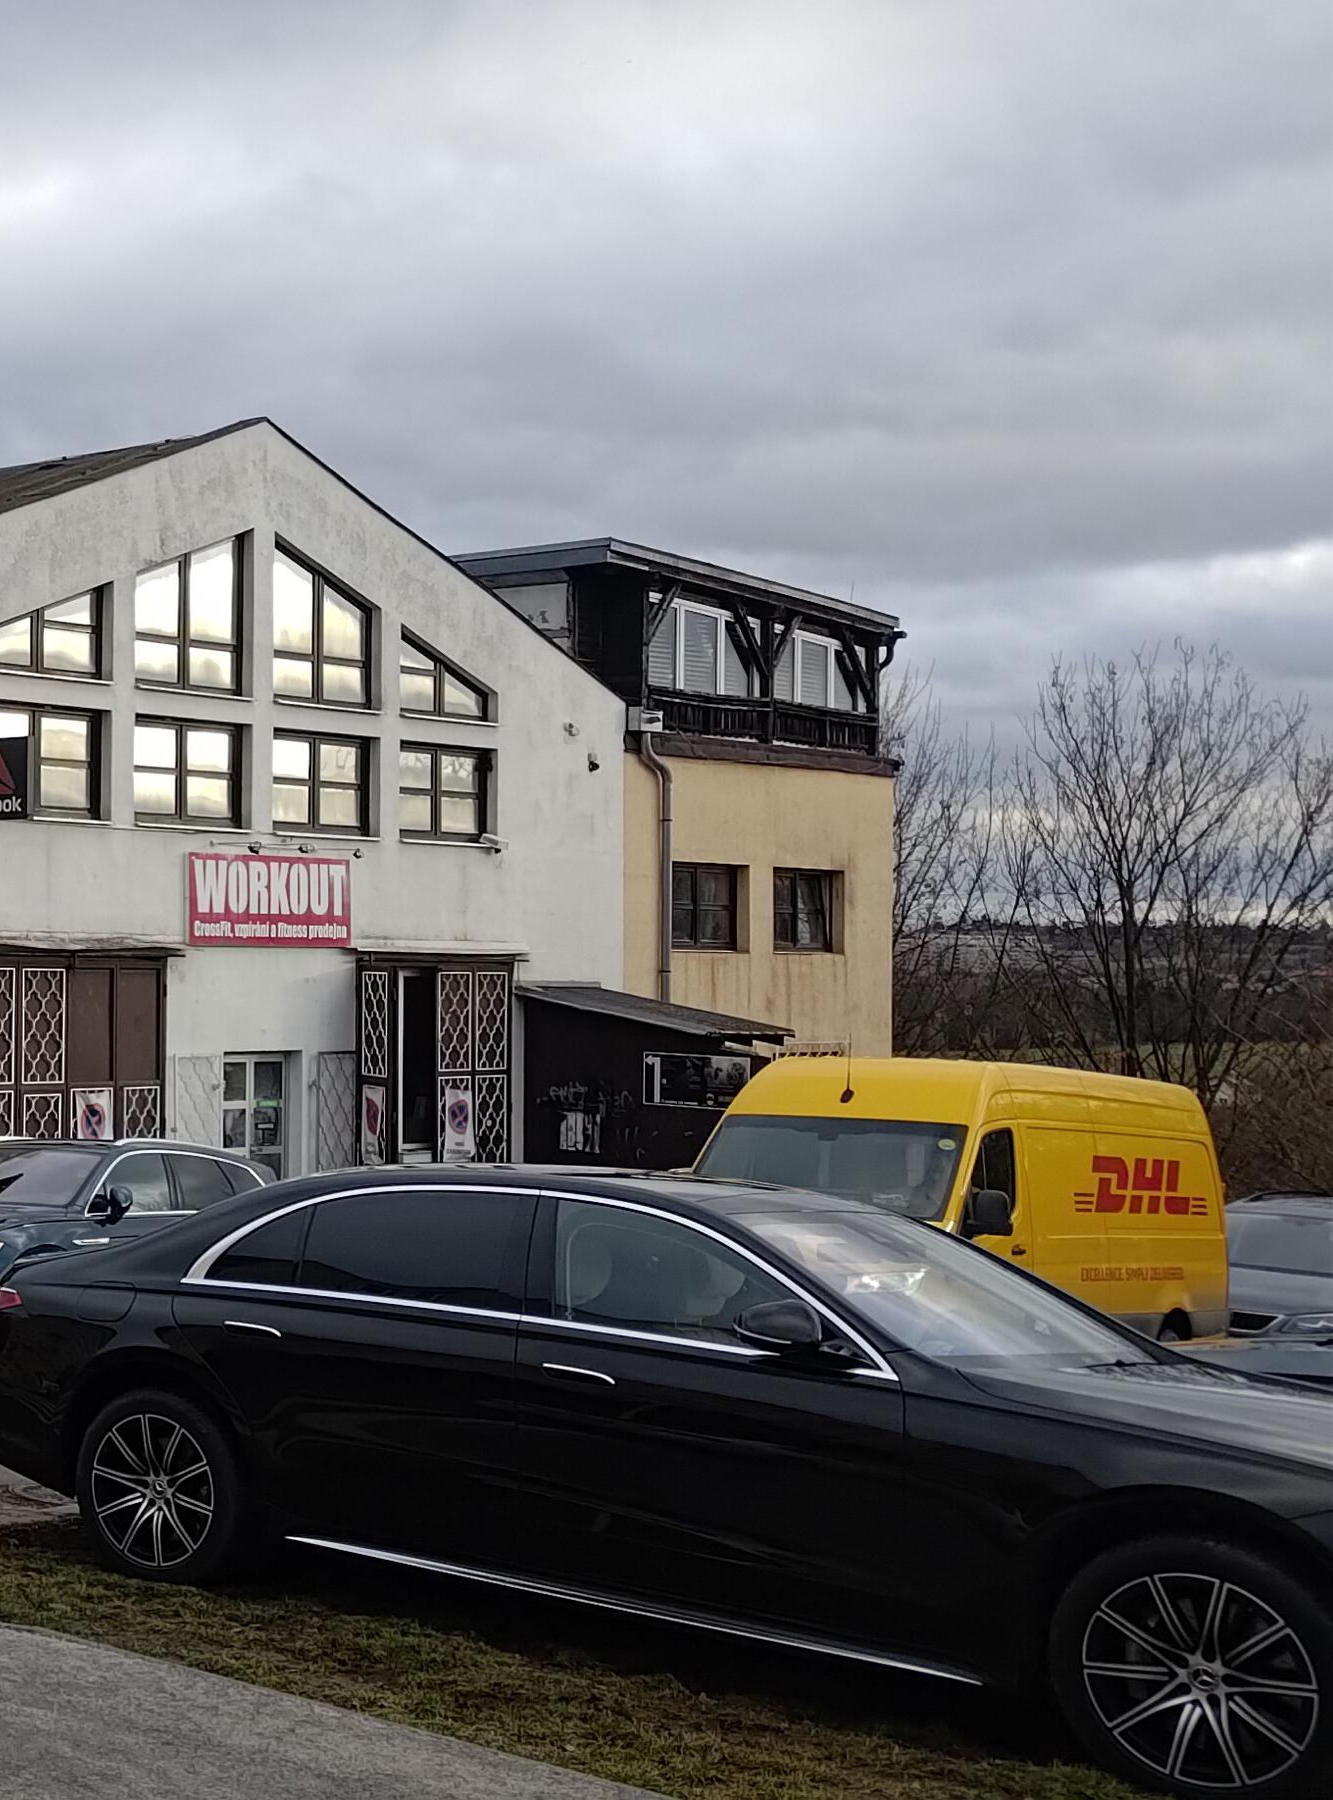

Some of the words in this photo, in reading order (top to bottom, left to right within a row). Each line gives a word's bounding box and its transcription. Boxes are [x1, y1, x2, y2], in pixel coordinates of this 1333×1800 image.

[193, 858, 346, 916] WORKOUT
[194, 920, 233, 938] CrossFit,
[278, 922, 307, 938] fitness
[308, 923, 347, 940] prodejna
[1092, 1155, 1190, 1215] DHL
